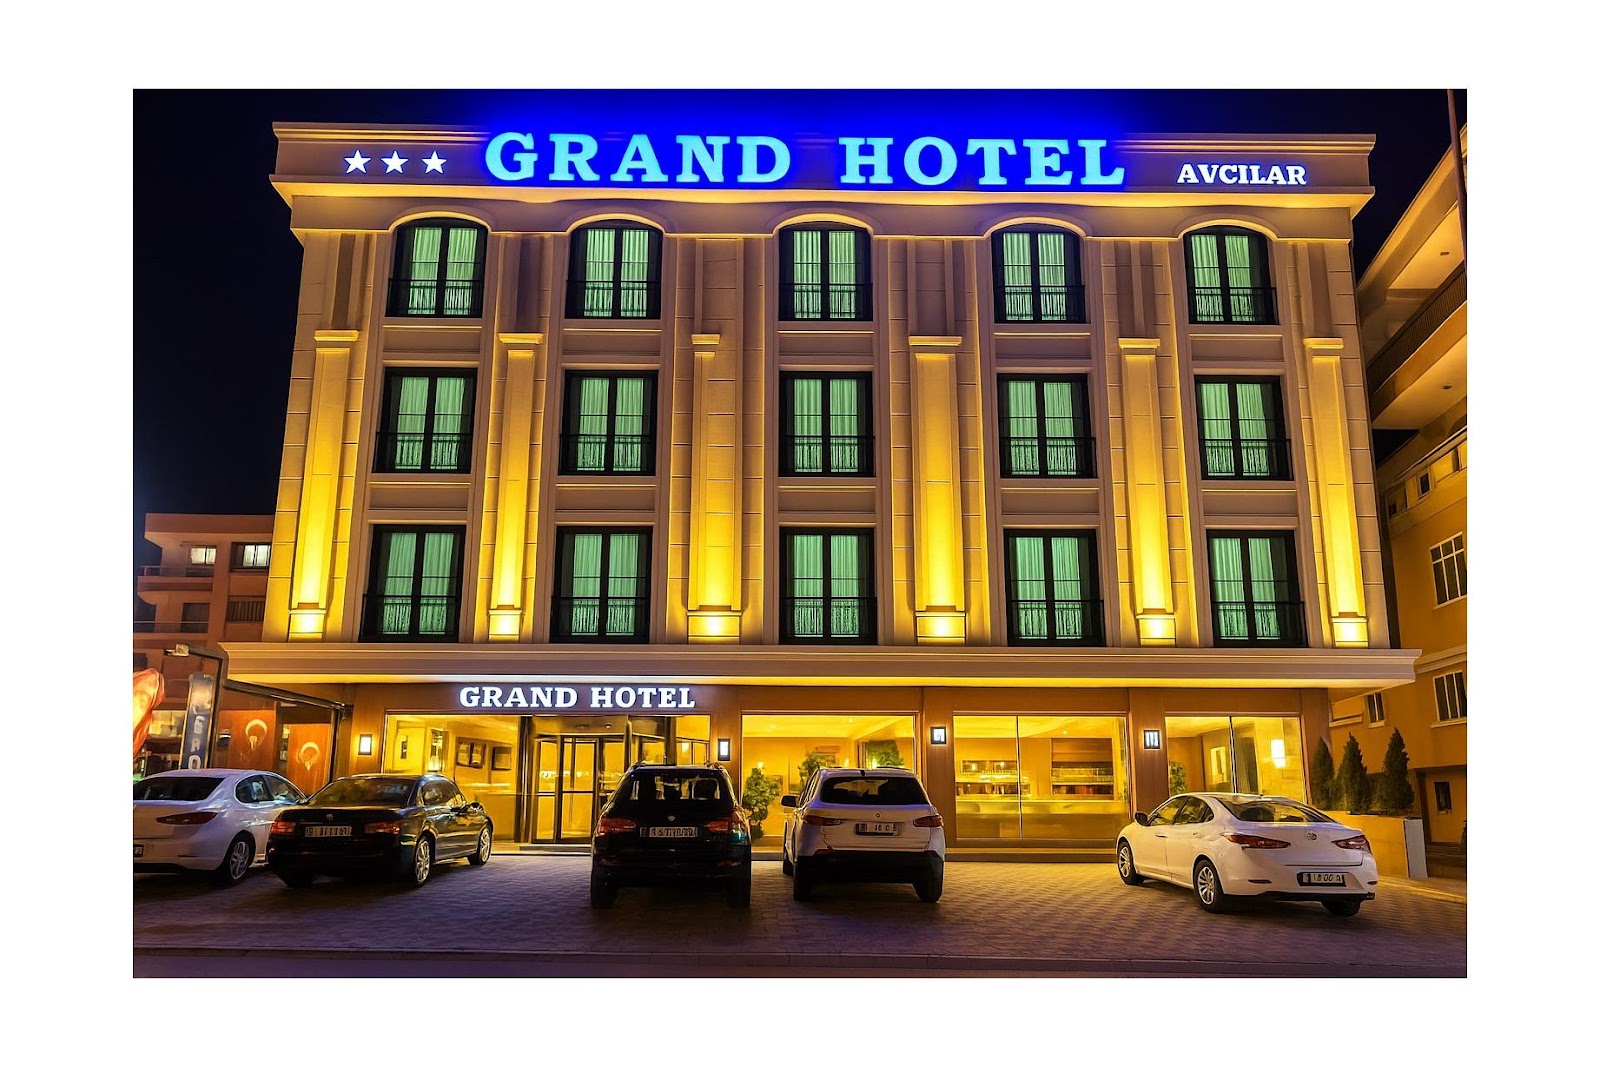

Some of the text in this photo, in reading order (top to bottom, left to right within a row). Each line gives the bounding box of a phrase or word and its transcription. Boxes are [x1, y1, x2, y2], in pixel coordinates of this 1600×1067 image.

[485, 131, 1126, 187] GRAND HOTEL
[1177, 163, 1307, 186] AVCILAR
[459, 686, 696, 709] GRAND HOTEL
